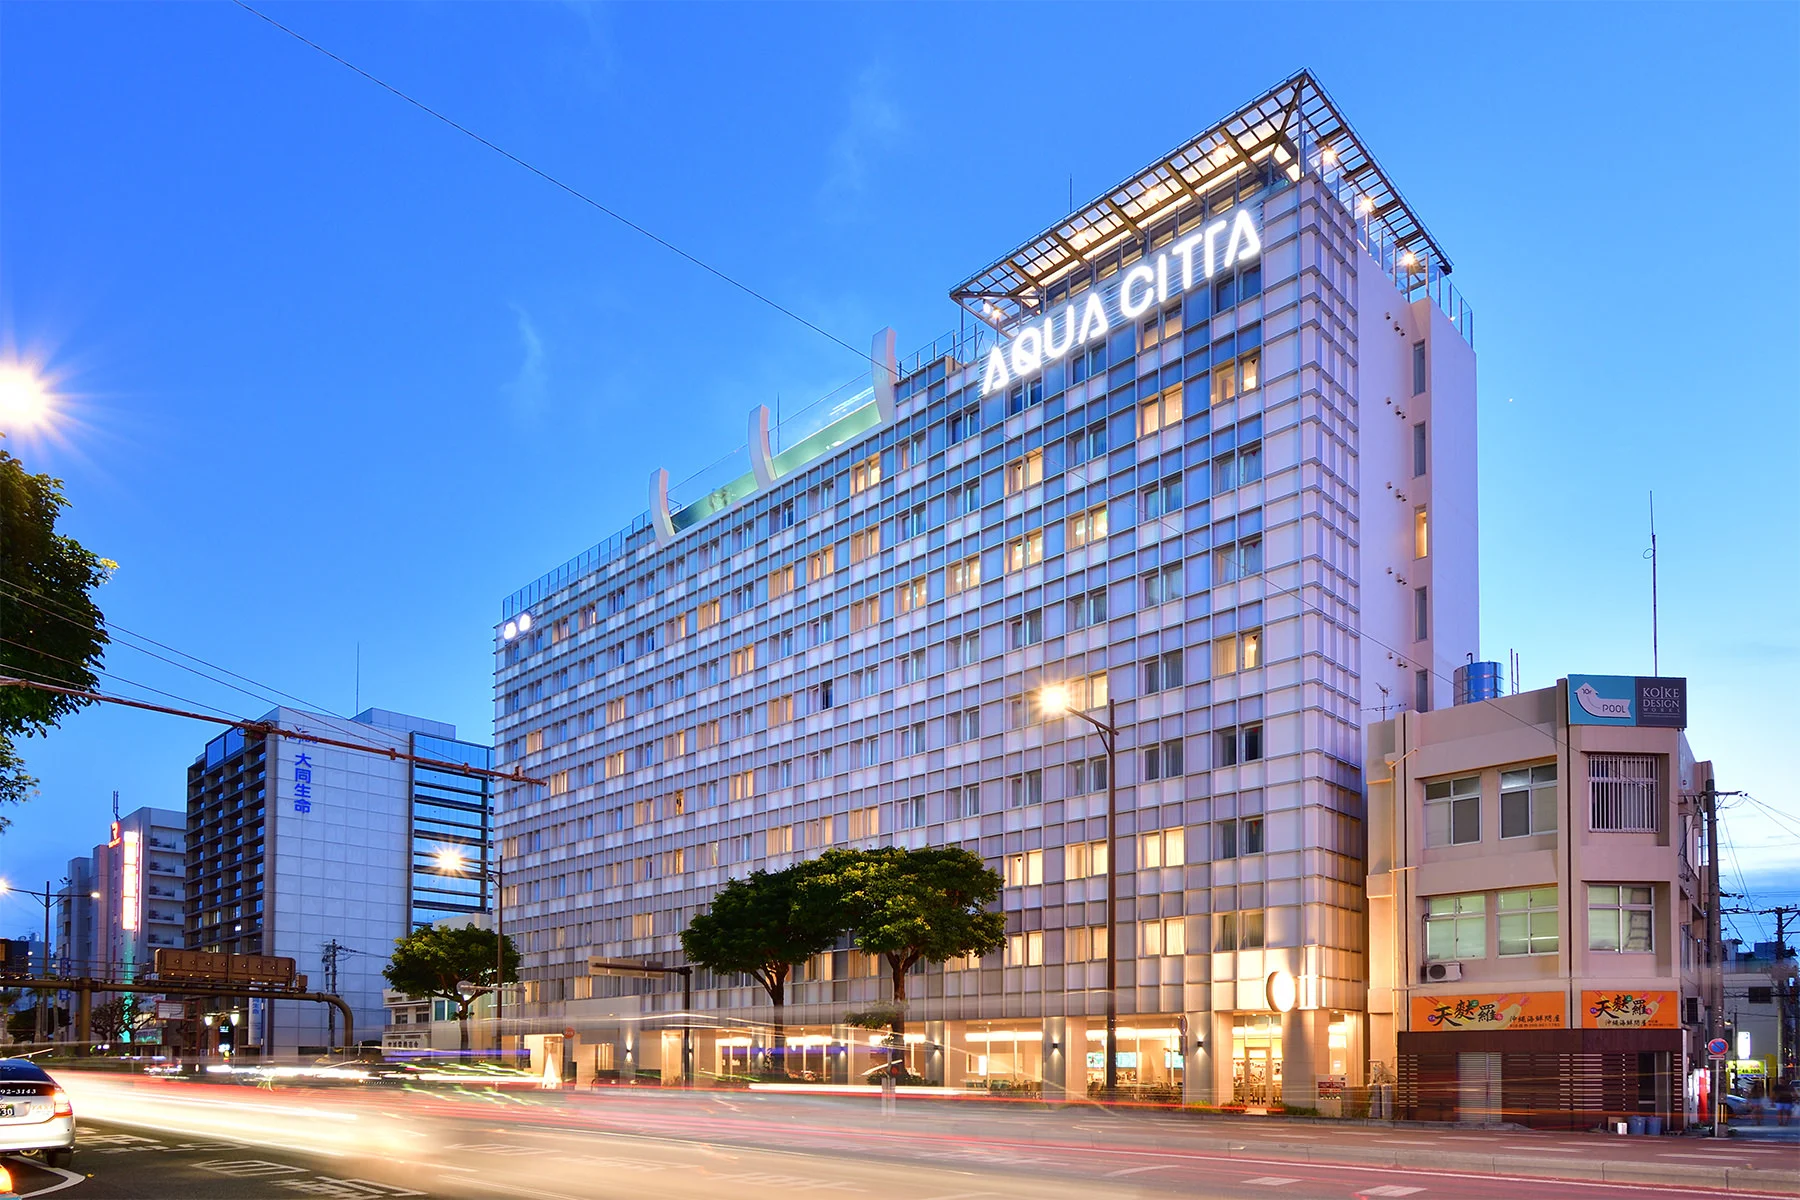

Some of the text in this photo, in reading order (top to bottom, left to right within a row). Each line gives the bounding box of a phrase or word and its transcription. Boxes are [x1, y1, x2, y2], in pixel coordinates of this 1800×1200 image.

[981, 208, 1262, 396] AQUA CITTA
[1643, 686, 1680, 699] KOIKE
[1602, 704, 1626, 713] POOL
[1643, 699, 1680, 708] DESIGN
[293, 752, 312, 814] 大同生命
